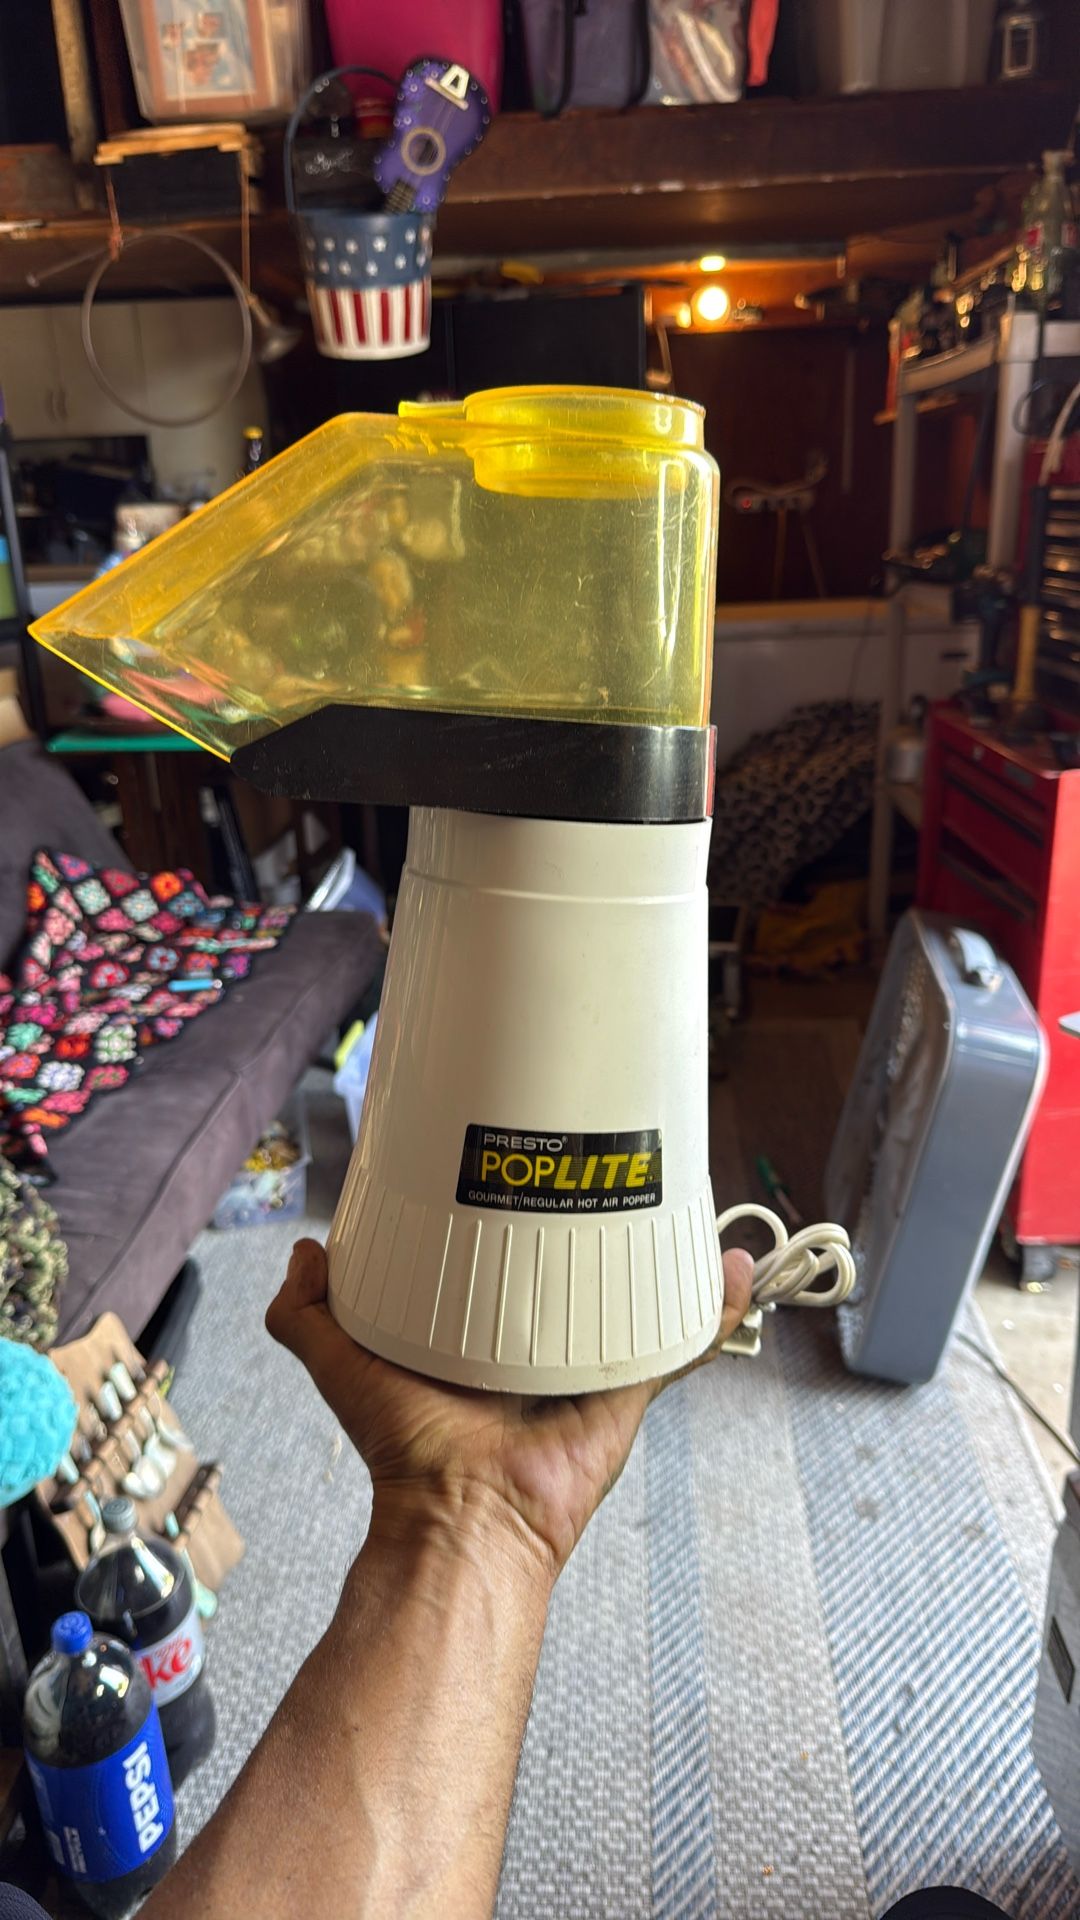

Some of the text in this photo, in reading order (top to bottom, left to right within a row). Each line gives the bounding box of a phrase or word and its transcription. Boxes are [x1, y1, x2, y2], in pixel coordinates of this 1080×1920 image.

[481, 1151, 652, 1190] POPLITE
[468, 1190, 656, 1209] GOURMET/REGULAR HOT AIR POPPER
[140, 1636, 194, 1689] ke
[122, 1741, 164, 1854] PEPSI
